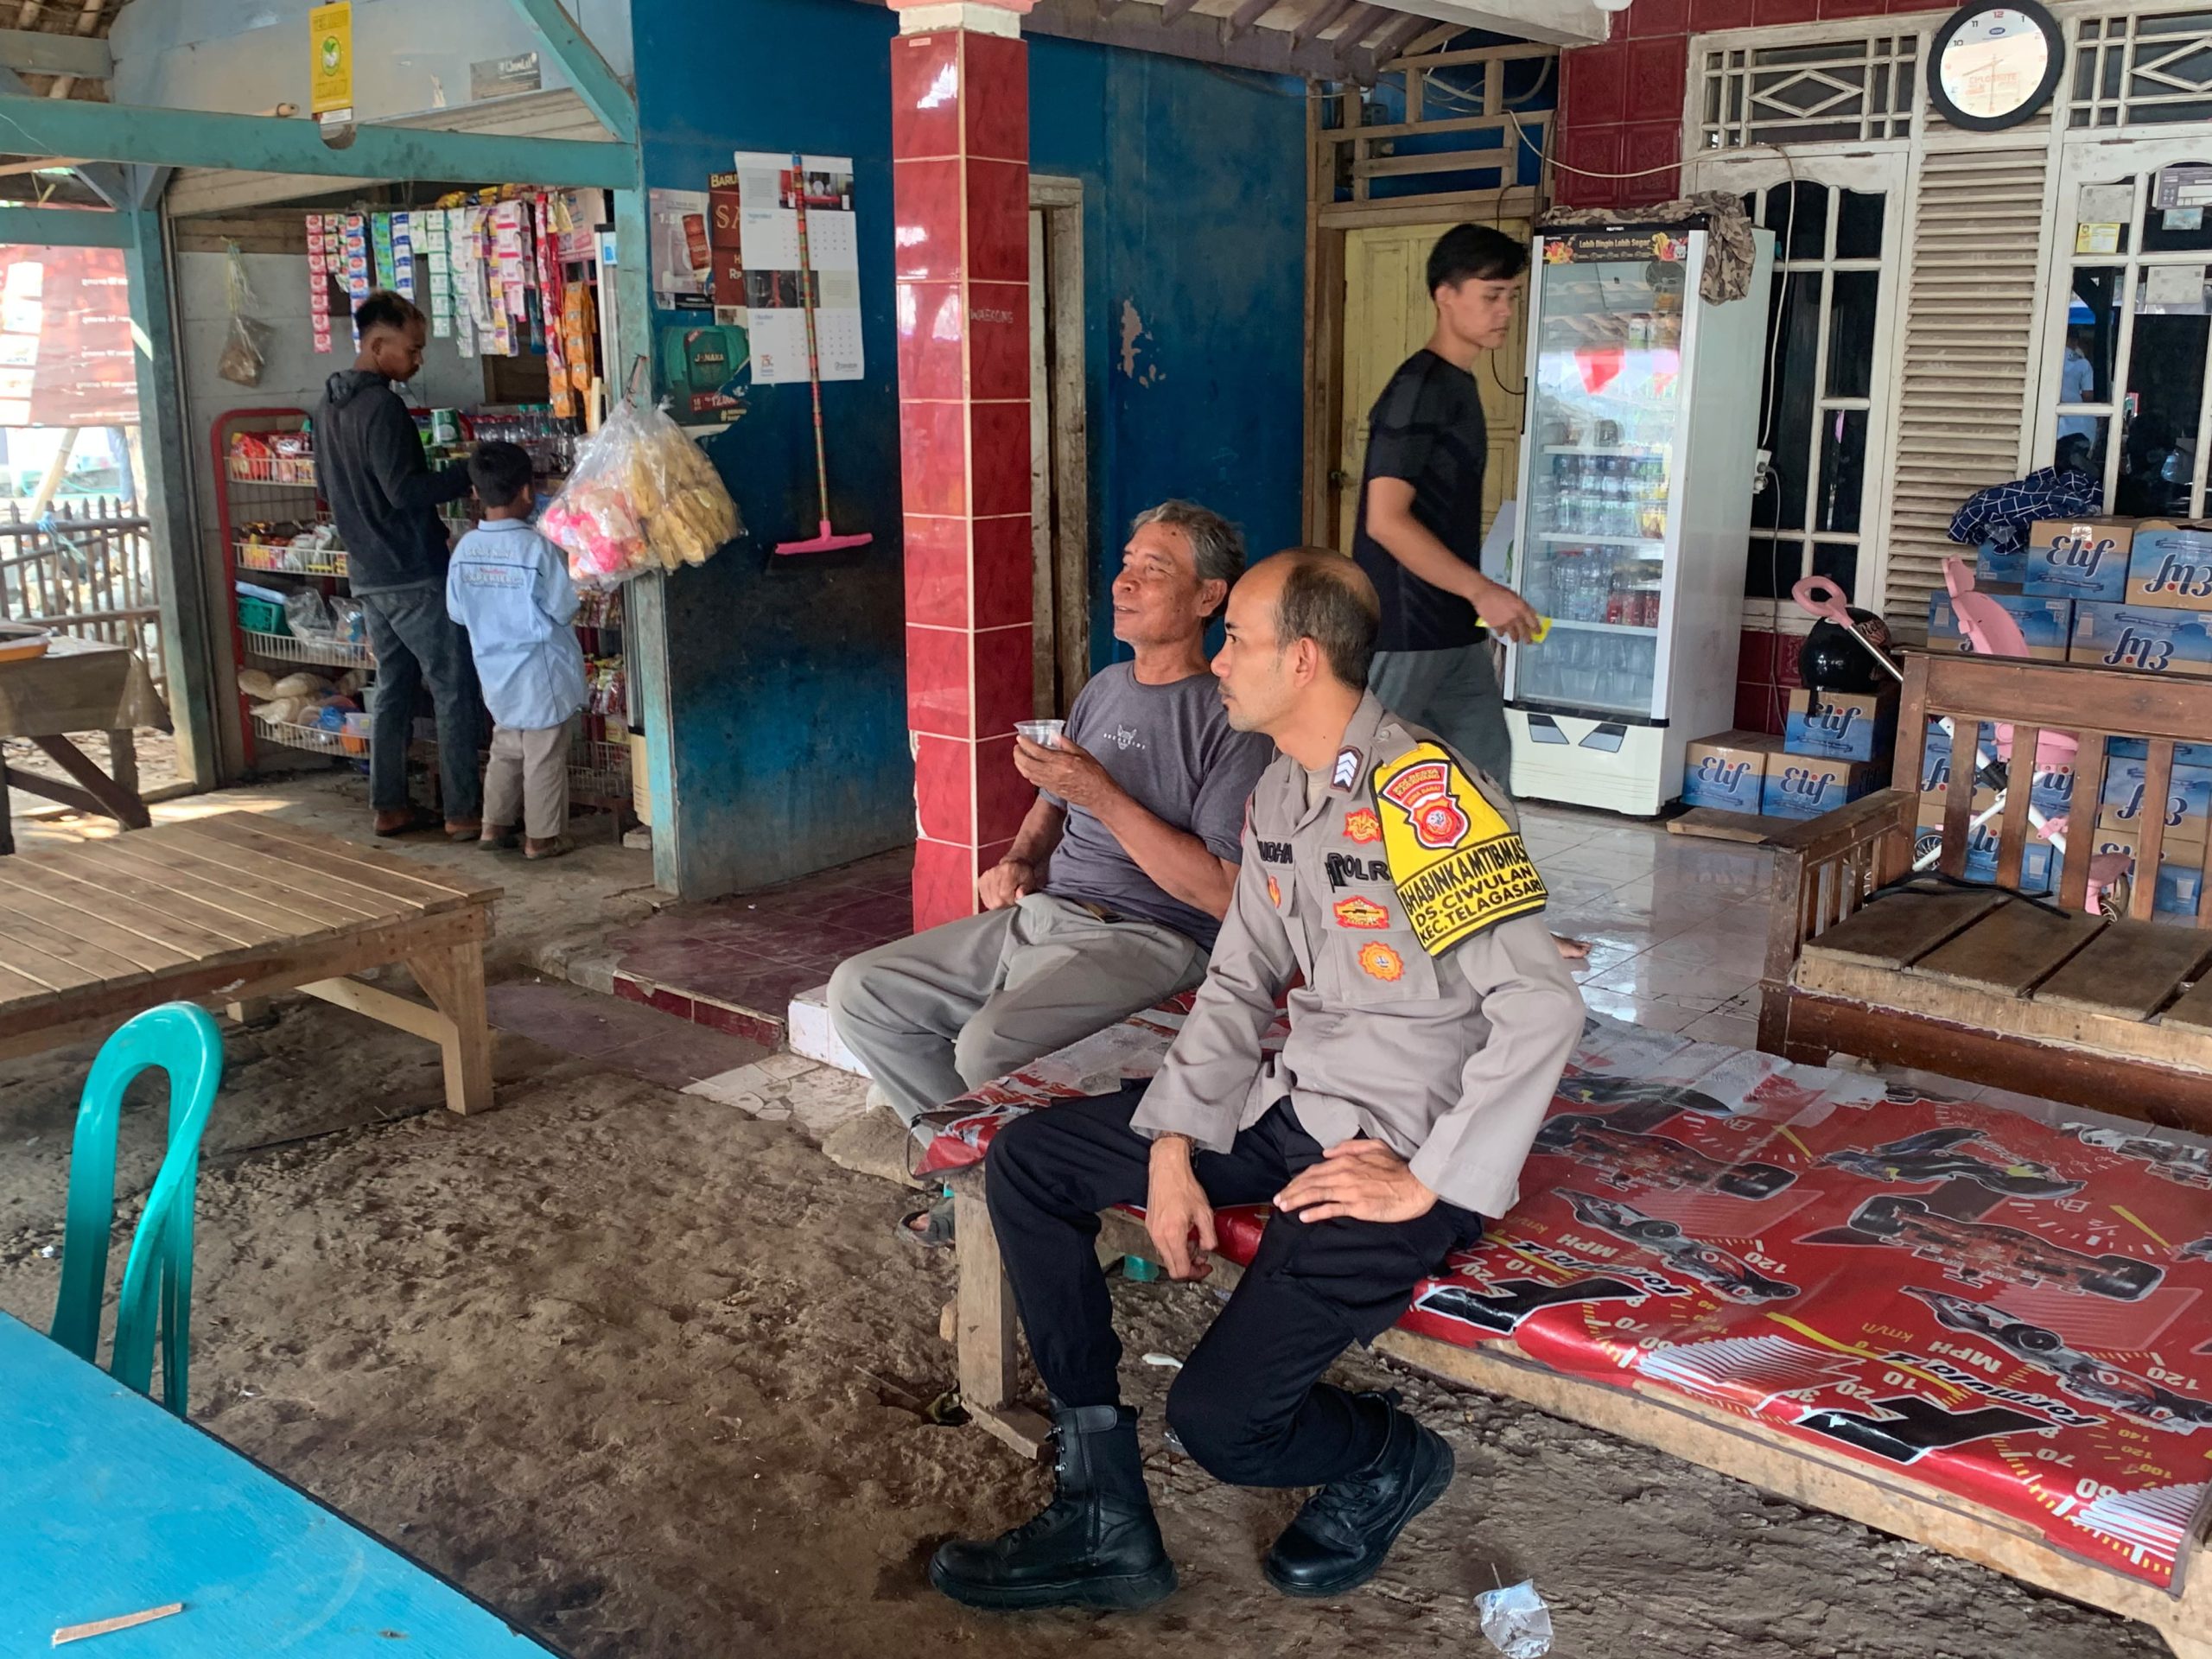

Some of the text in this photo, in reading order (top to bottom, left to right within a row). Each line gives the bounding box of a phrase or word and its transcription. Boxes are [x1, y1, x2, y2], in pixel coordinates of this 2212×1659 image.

[2045, 536, 2115, 578] Elif
[2103, 627, 2175, 671] Elif
[1697, 756, 1751, 793] Elif
[1780, 767, 1835, 804] Elif
[1556, 1233, 1619, 1258] MPH
[1461, 1263, 1497, 1282] 20
[1504, 1258, 1534, 1277] 10
[1543, 1251, 1694, 1297] Formula
[1744, 1252, 1788, 1274] 120
[1614, 1317, 1647, 1332] 70
[1927, 1339, 2003, 1375] MPH
[1882, 1370, 1917, 1390] 10
[2146, 1366, 2200, 1391] 120
[1834, 1382, 1876, 1402] 20
[1919, 1355, 2109, 1427] Formula
[2118, 1428, 2151, 1443] 140
[2036, 1447, 2077, 1468] 70
[2120, 1445, 2153, 1460] 120
[2139, 1462, 2173, 1480] 100
